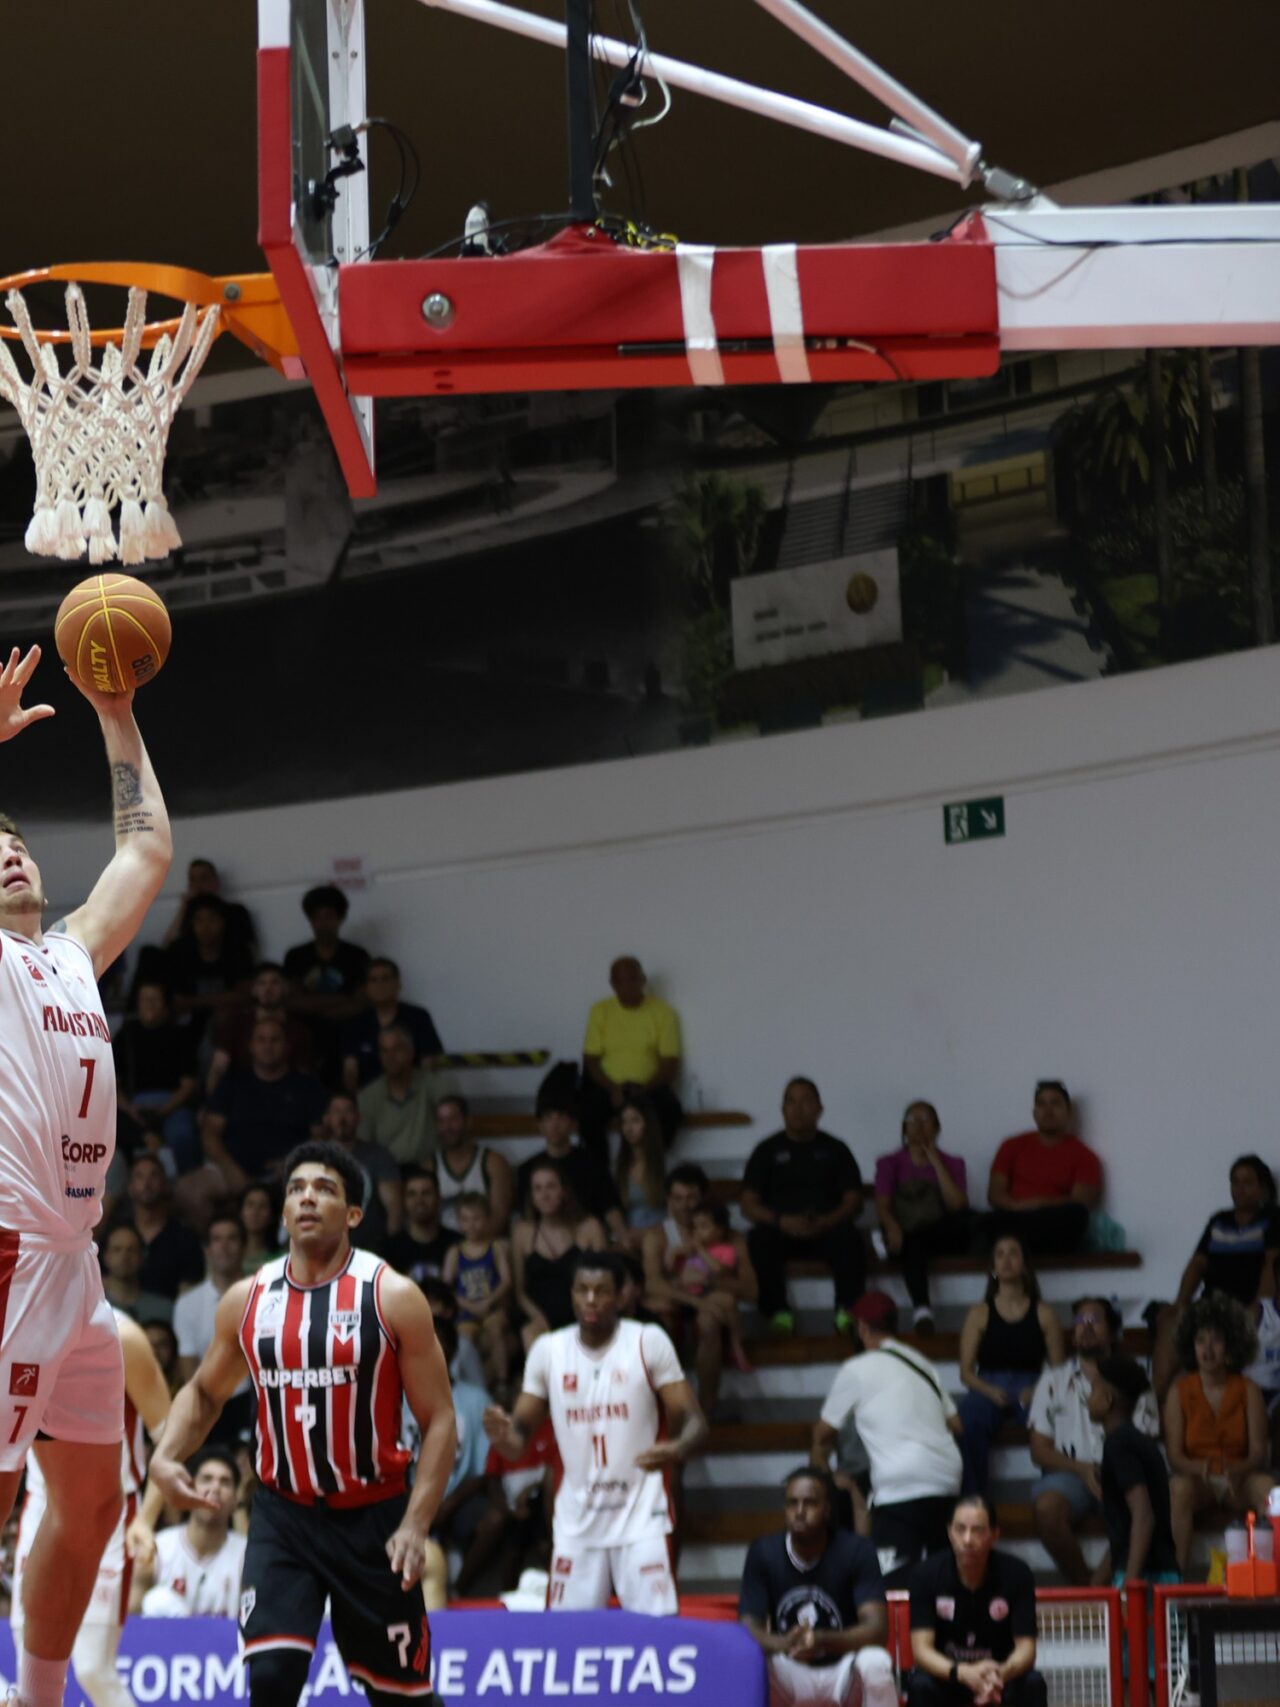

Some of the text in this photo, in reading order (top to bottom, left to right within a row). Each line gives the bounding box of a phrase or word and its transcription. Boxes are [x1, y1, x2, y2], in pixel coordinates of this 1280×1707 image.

[77, 1057, 97, 1119] 7
[258, 1365, 358, 1389] SUPERBET
[8, 1404, 29, 1445] 7
[294, 1404, 317, 1441] 7
[386, 1621, 412, 1669] 7
[476, 1644, 698, 1697] ATLETAS
